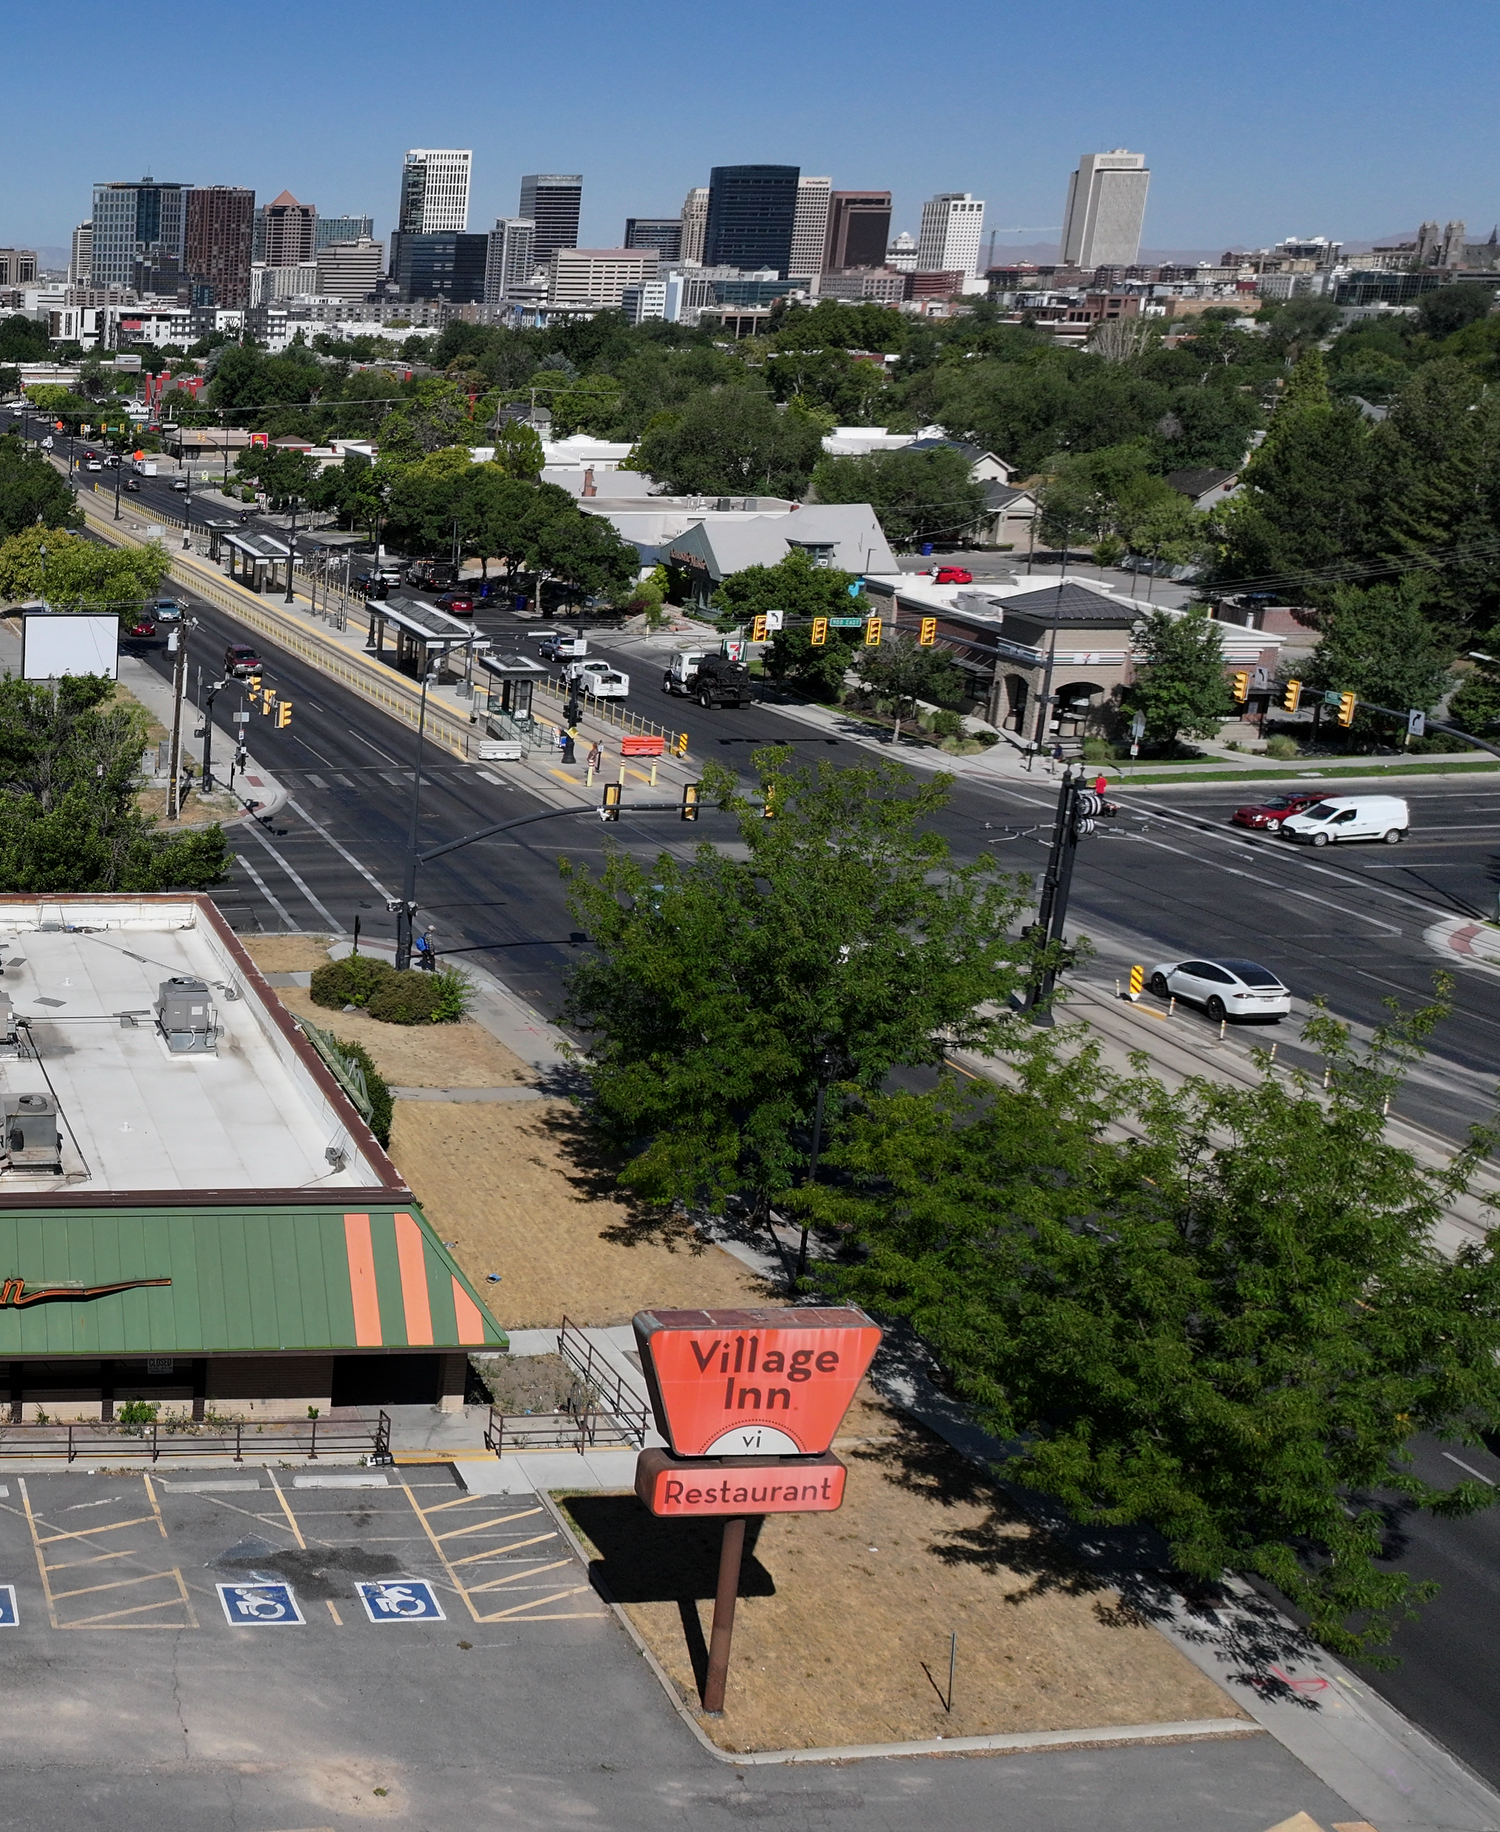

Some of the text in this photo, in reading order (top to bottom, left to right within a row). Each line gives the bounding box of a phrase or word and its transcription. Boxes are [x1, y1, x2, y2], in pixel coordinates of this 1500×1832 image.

[148, 1357, 172, 1367] CLOSED
[690, 1335, 840, 1383] Village
[724, 1376, 792, 1411] Inn
[742, 1430, 762, 1449] vi
[664, 1476, 832, 1506] Restaurant
